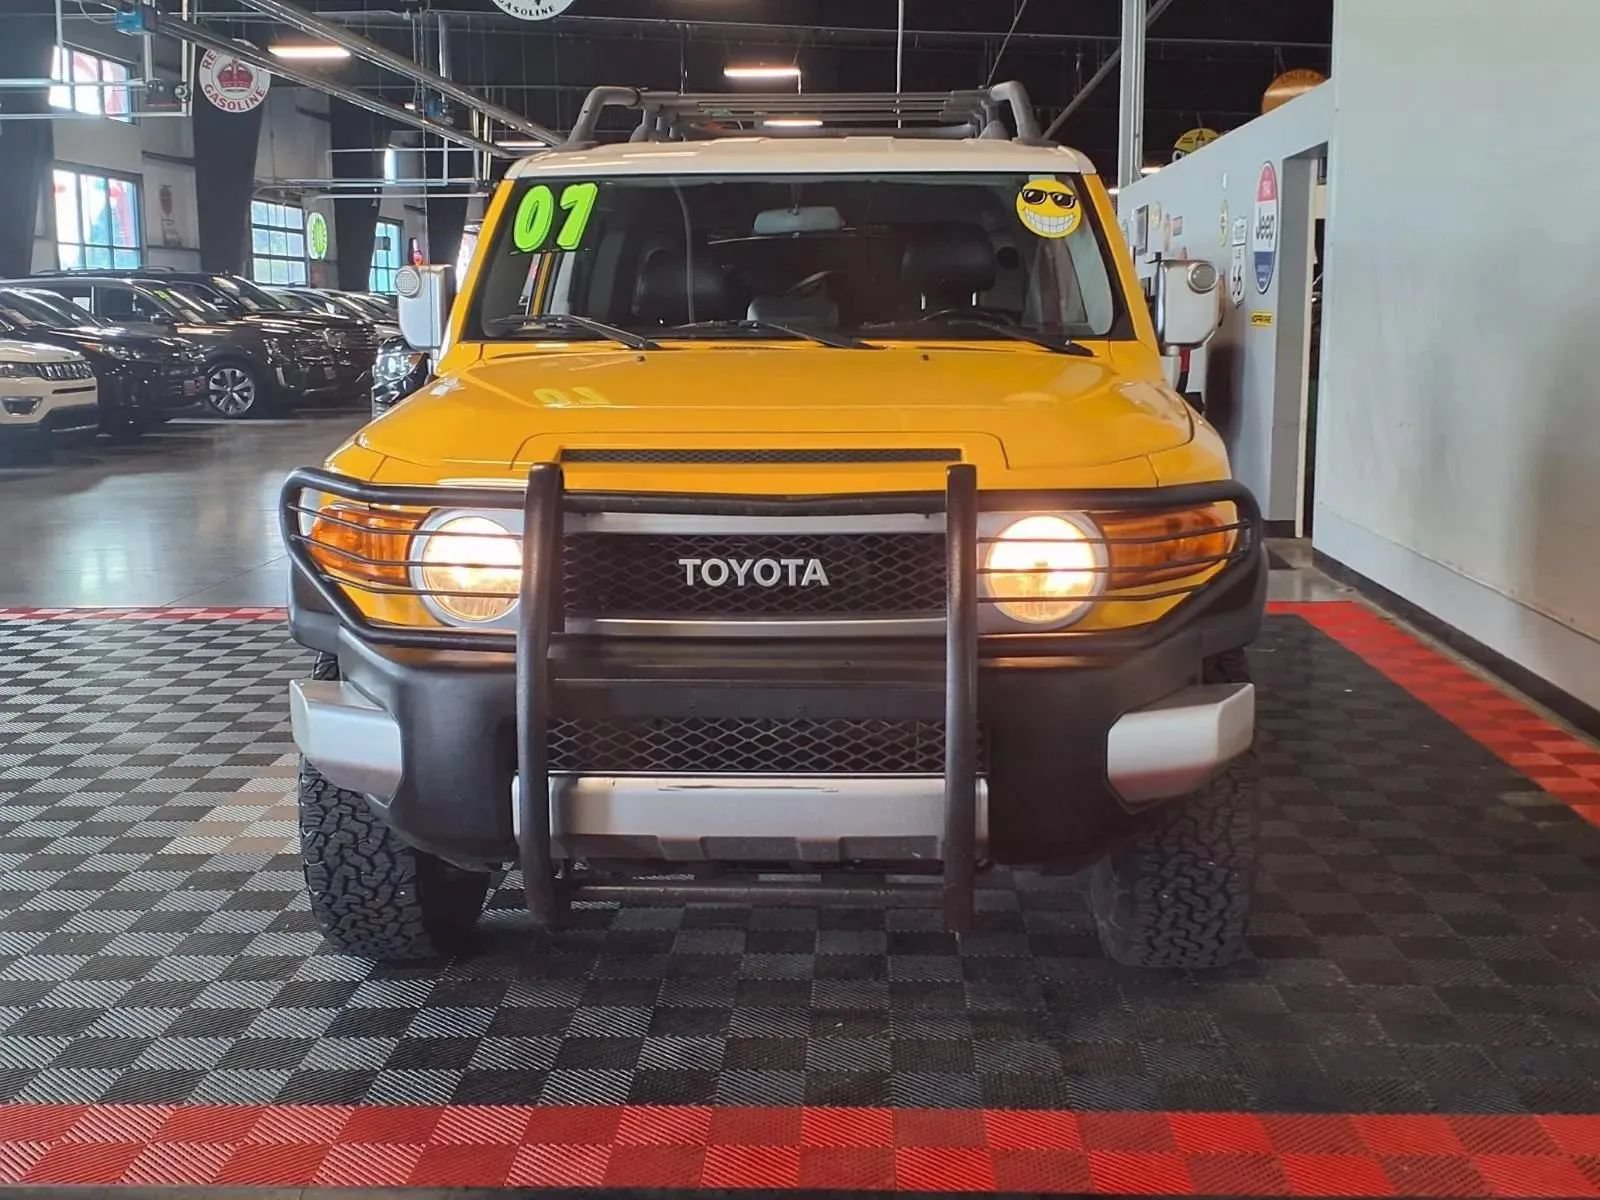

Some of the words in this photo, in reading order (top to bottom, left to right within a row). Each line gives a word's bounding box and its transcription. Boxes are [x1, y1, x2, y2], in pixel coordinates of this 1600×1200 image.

[202, 50, 217, 70] RE
[204, 84, 266, 110] GASOLINE
[513, 182, 598, 252] 07
[1255, 207, 1275, 248] Jeep
[678, 558, 830, 587] TOYOTA
